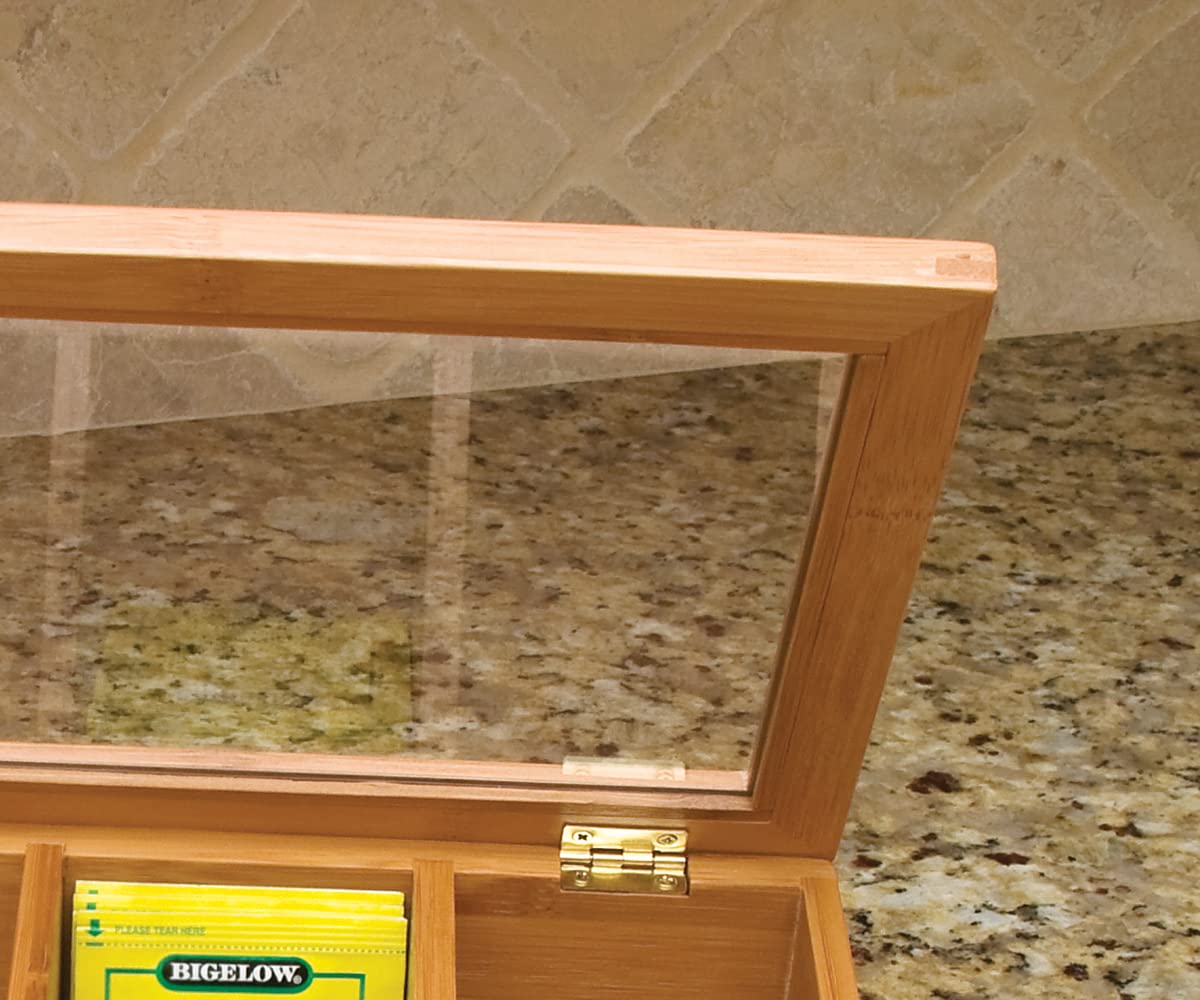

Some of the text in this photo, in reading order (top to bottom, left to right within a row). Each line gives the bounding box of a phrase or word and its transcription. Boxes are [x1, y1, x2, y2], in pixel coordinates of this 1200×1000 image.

[114, 925, 206, 936] PLEASE TEAR HERE
[168, 961, 301, 983] BIGELOW
